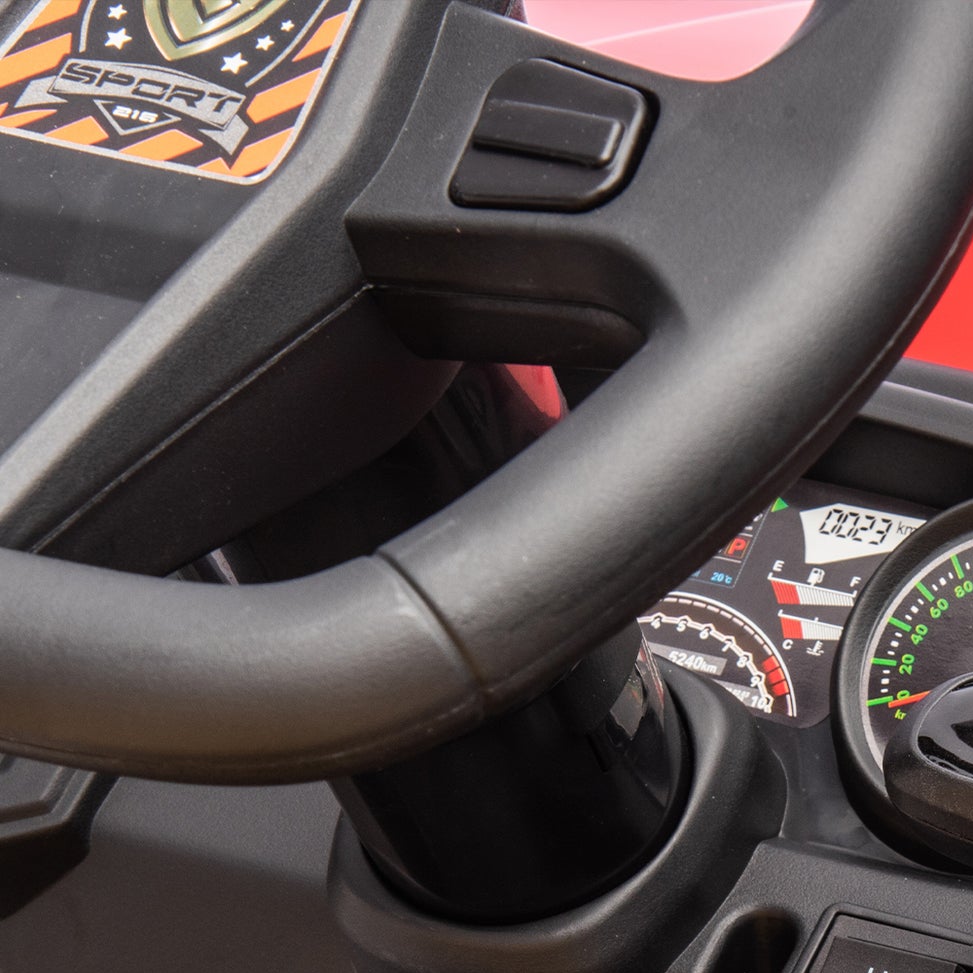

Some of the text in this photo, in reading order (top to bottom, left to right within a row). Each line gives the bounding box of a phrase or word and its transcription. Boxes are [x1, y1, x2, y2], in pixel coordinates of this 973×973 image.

[60, 62, 243, 114] SPORT
[819, 508, 893, 546] 0023
[727, 537, 748, 556] P
[772, 559, 785, 572] E
[849, 576, 861, 588] F
[782, 638, 794, 650] C
[898, 653, 916, 676] 20
[910, 623, 929, 646] 40
[930, 598, 950, 619] 60
[736, 656, 749, 668] 8
[750, 676, 761, 688] 9
